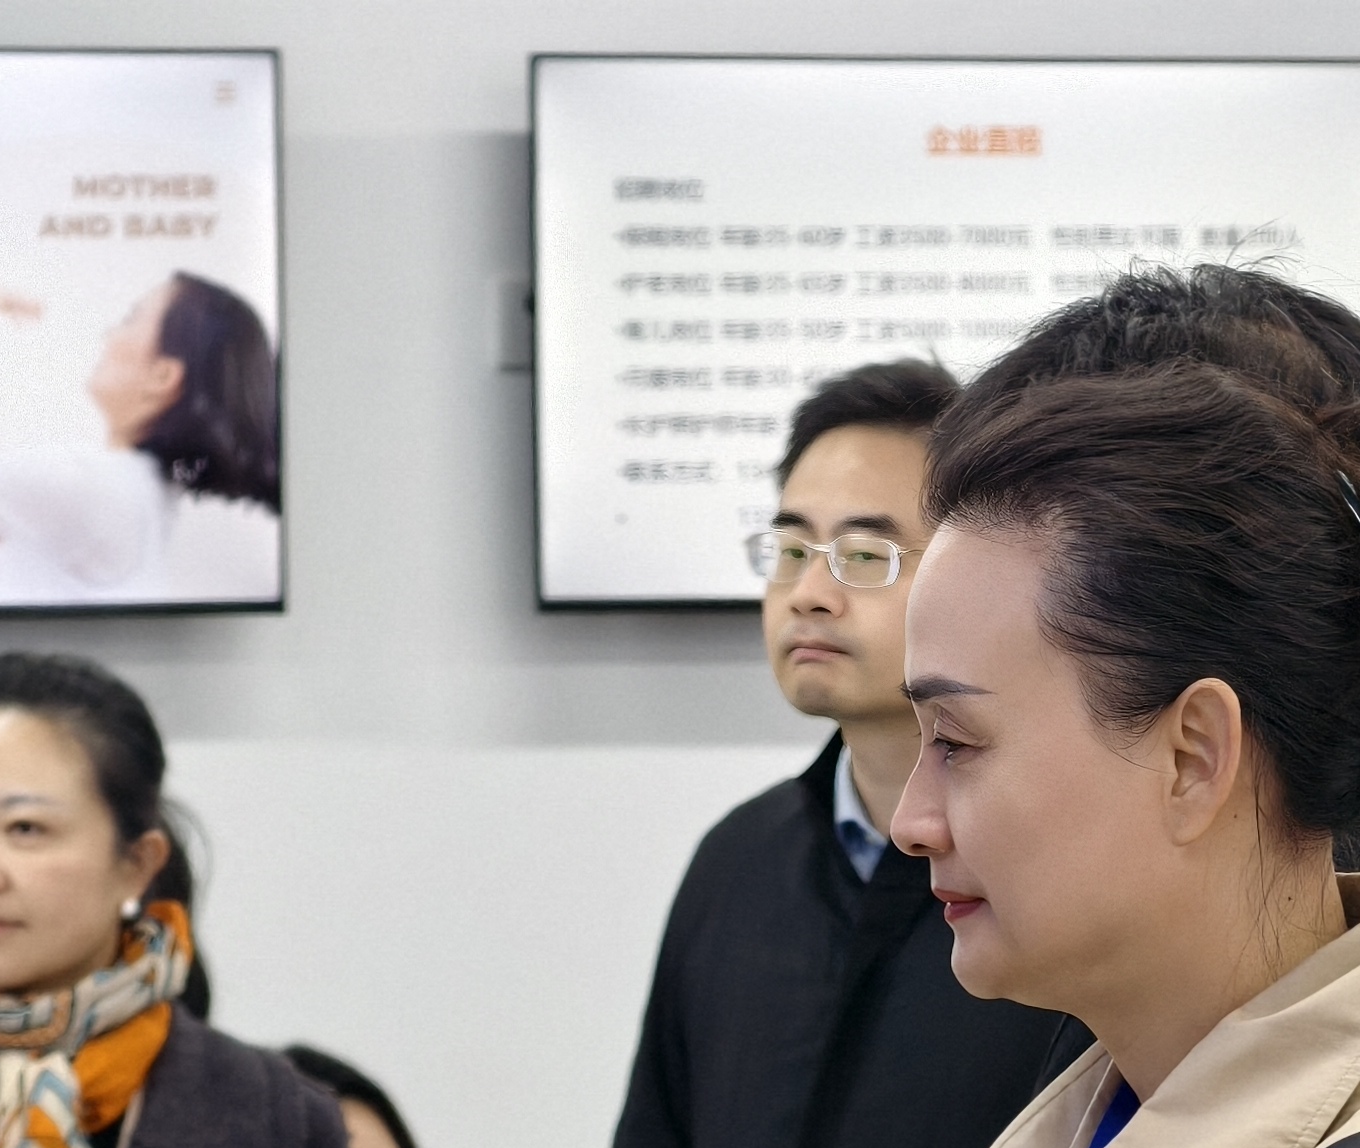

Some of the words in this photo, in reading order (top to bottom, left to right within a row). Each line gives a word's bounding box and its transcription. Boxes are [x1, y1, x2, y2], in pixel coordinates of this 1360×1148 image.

[72, 174, 216, 199] MOTHER
[40, 214, 113, 238] AND
[122, 213, 218, 238] BABY
